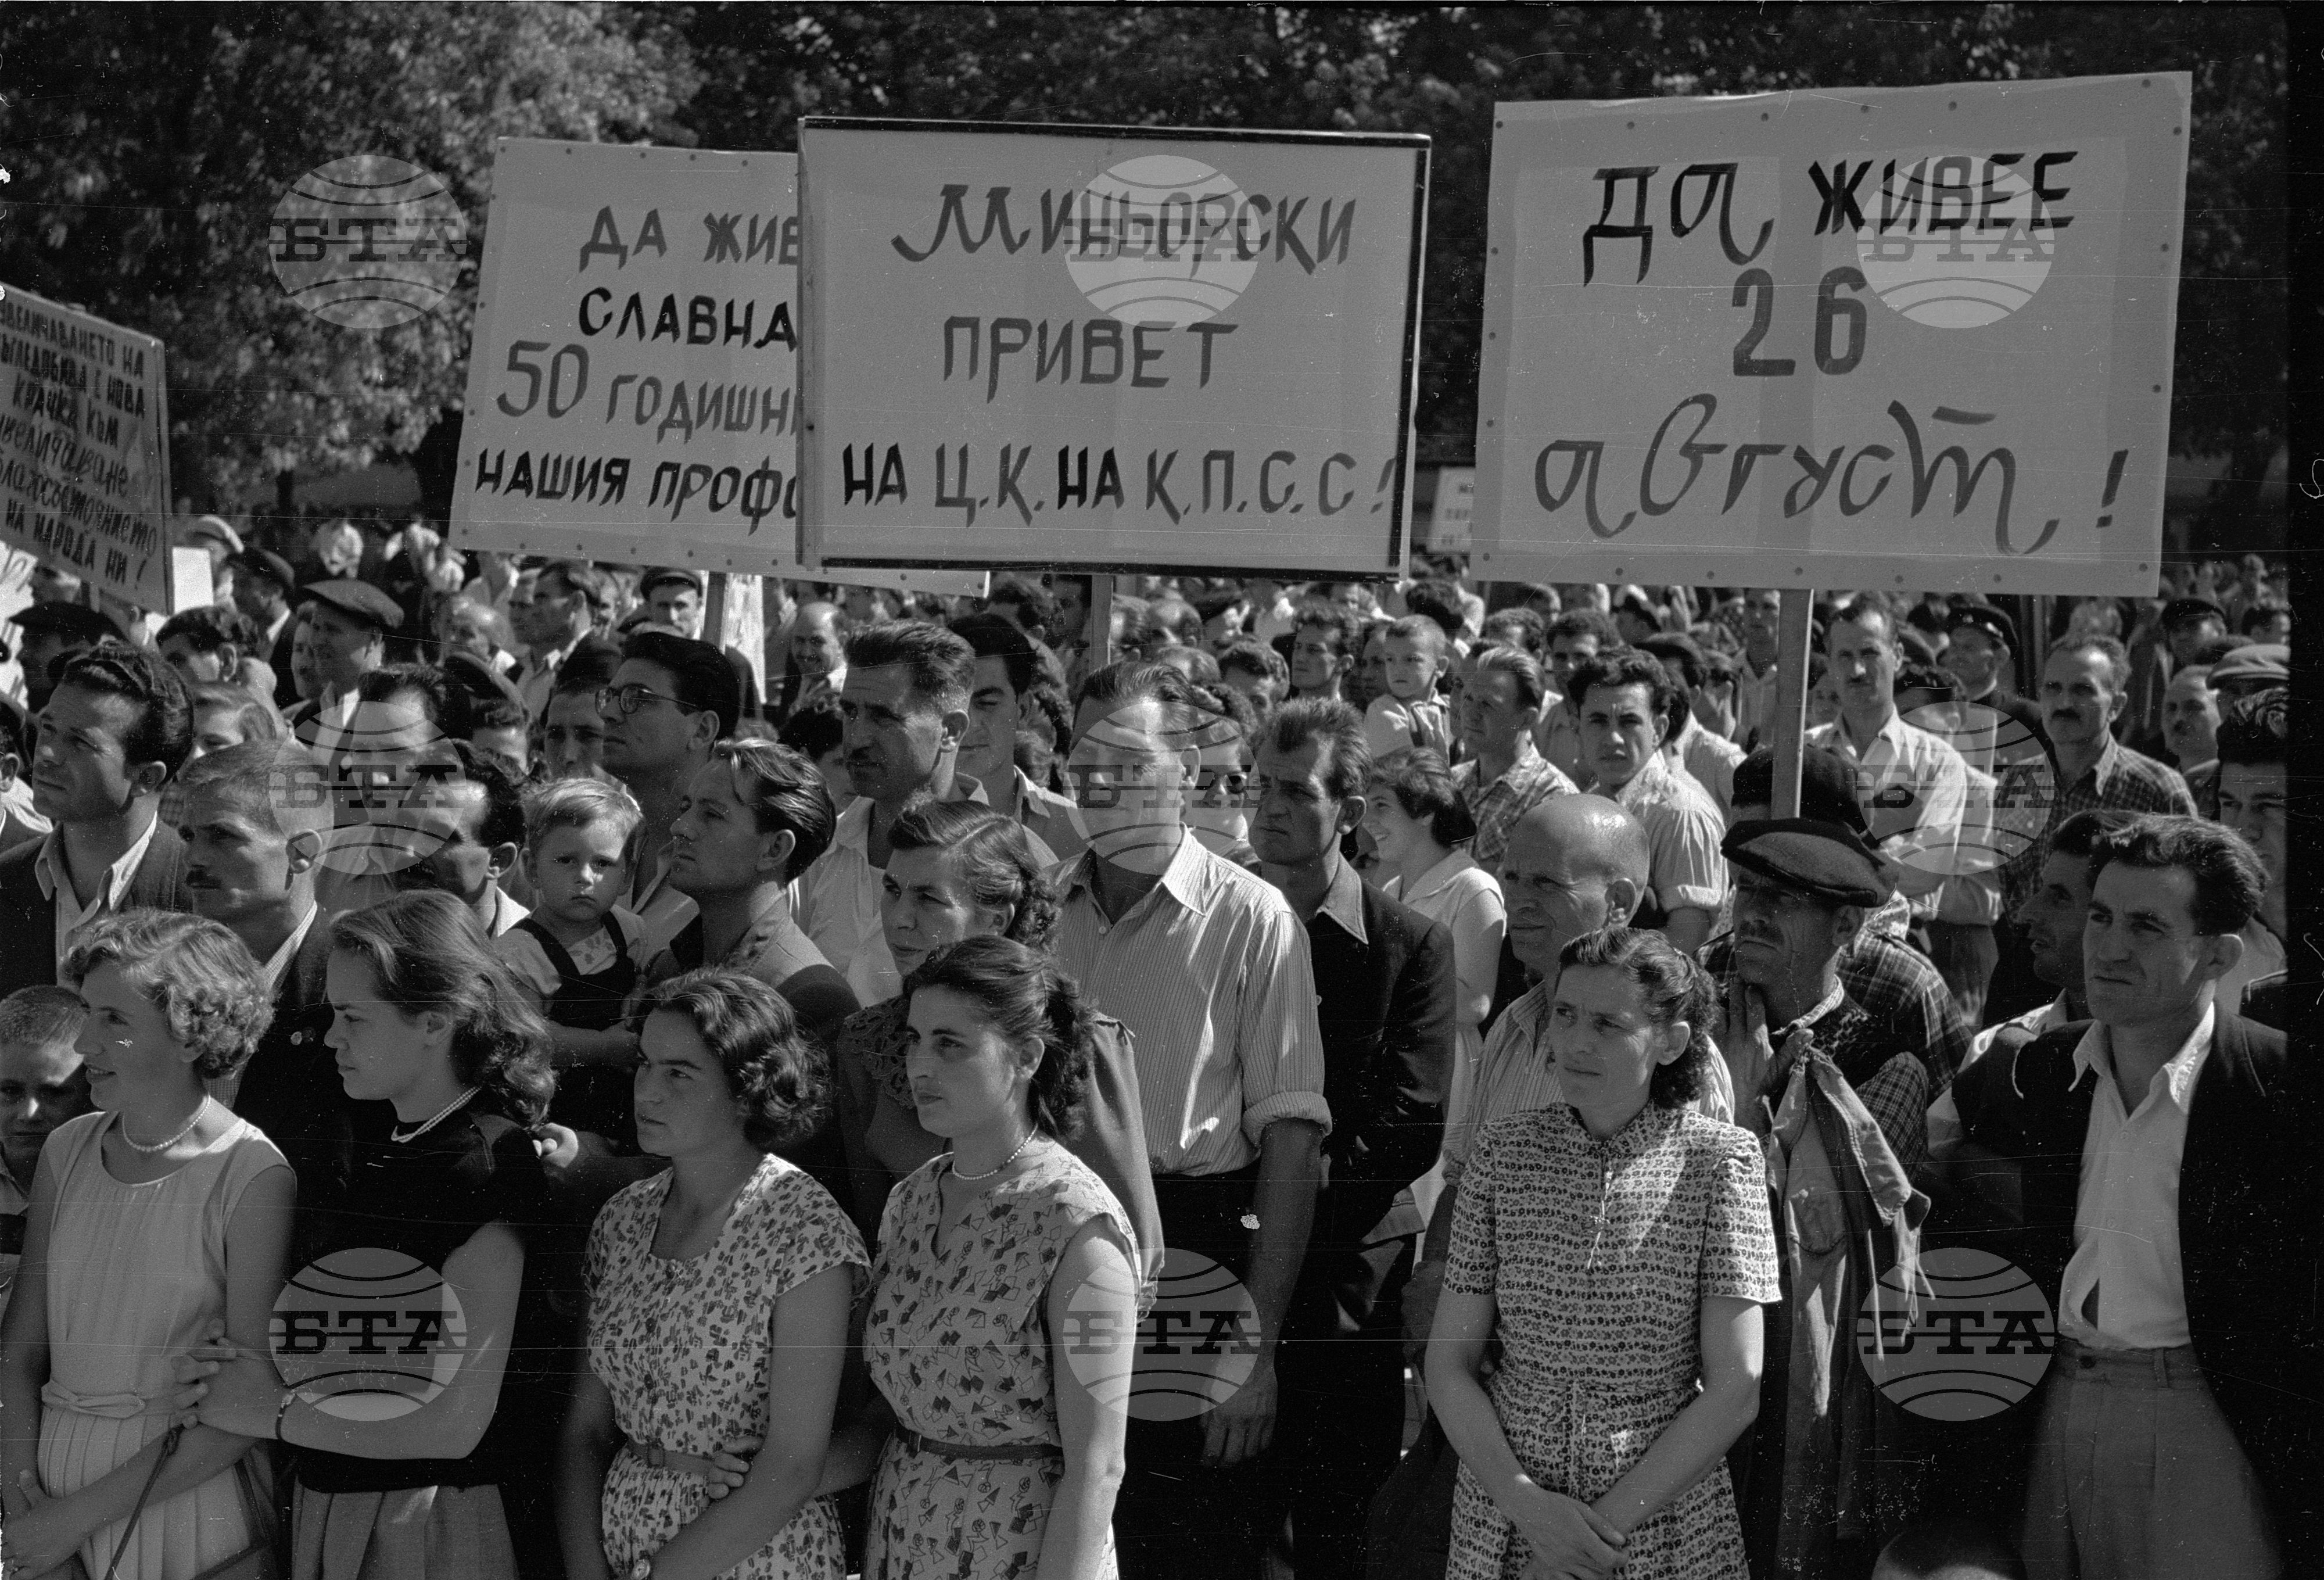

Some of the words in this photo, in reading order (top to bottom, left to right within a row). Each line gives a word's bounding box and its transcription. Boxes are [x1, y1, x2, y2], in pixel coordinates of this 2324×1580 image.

[1807, 151, 2078, 235] ЖИВЕЕ
[580, 206, 667, 273] ДА
[579, 287, 798, 353] СЛАВНА
[1731, 266, 1868, 377] 26
[123, 345, 144, 379] НА
[497, 340, 590, 419] 50
[606, 374, 796, 445] ГОДИШН
[944, 316, 1239, 404] ПРИВЕТ
[107, 374, 145, 420] НОВА
[475, 447, 630, 507] НАШИЯ
[842, 442, 909, 507] НА
[1057, 445, 1125, 510] НА
[6, 499, 25, 533] НА
